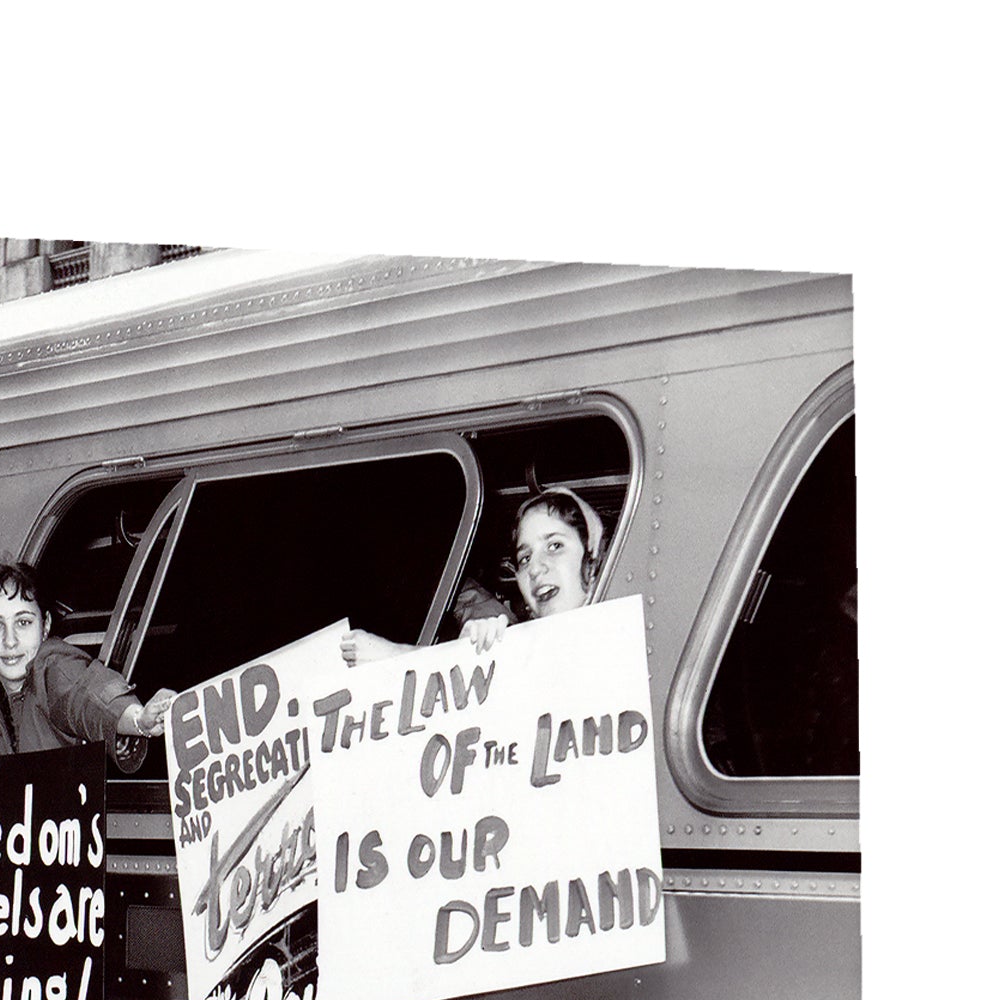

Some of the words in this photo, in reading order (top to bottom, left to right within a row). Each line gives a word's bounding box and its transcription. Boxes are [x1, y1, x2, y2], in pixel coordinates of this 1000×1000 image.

[397, 660, 495, 736] LAW
[419, 727, 481, 798] OF
[484, 740, 519, 769] THE
[530, 710, 648, 787] LAND
[179, 811, 212, 848] AND
[334, 831, 390, 893] IS
[407, 815, 510, 879] OUR
[48, 883, 105, 947] are
[434, 867, 664, 965] DEMAND
